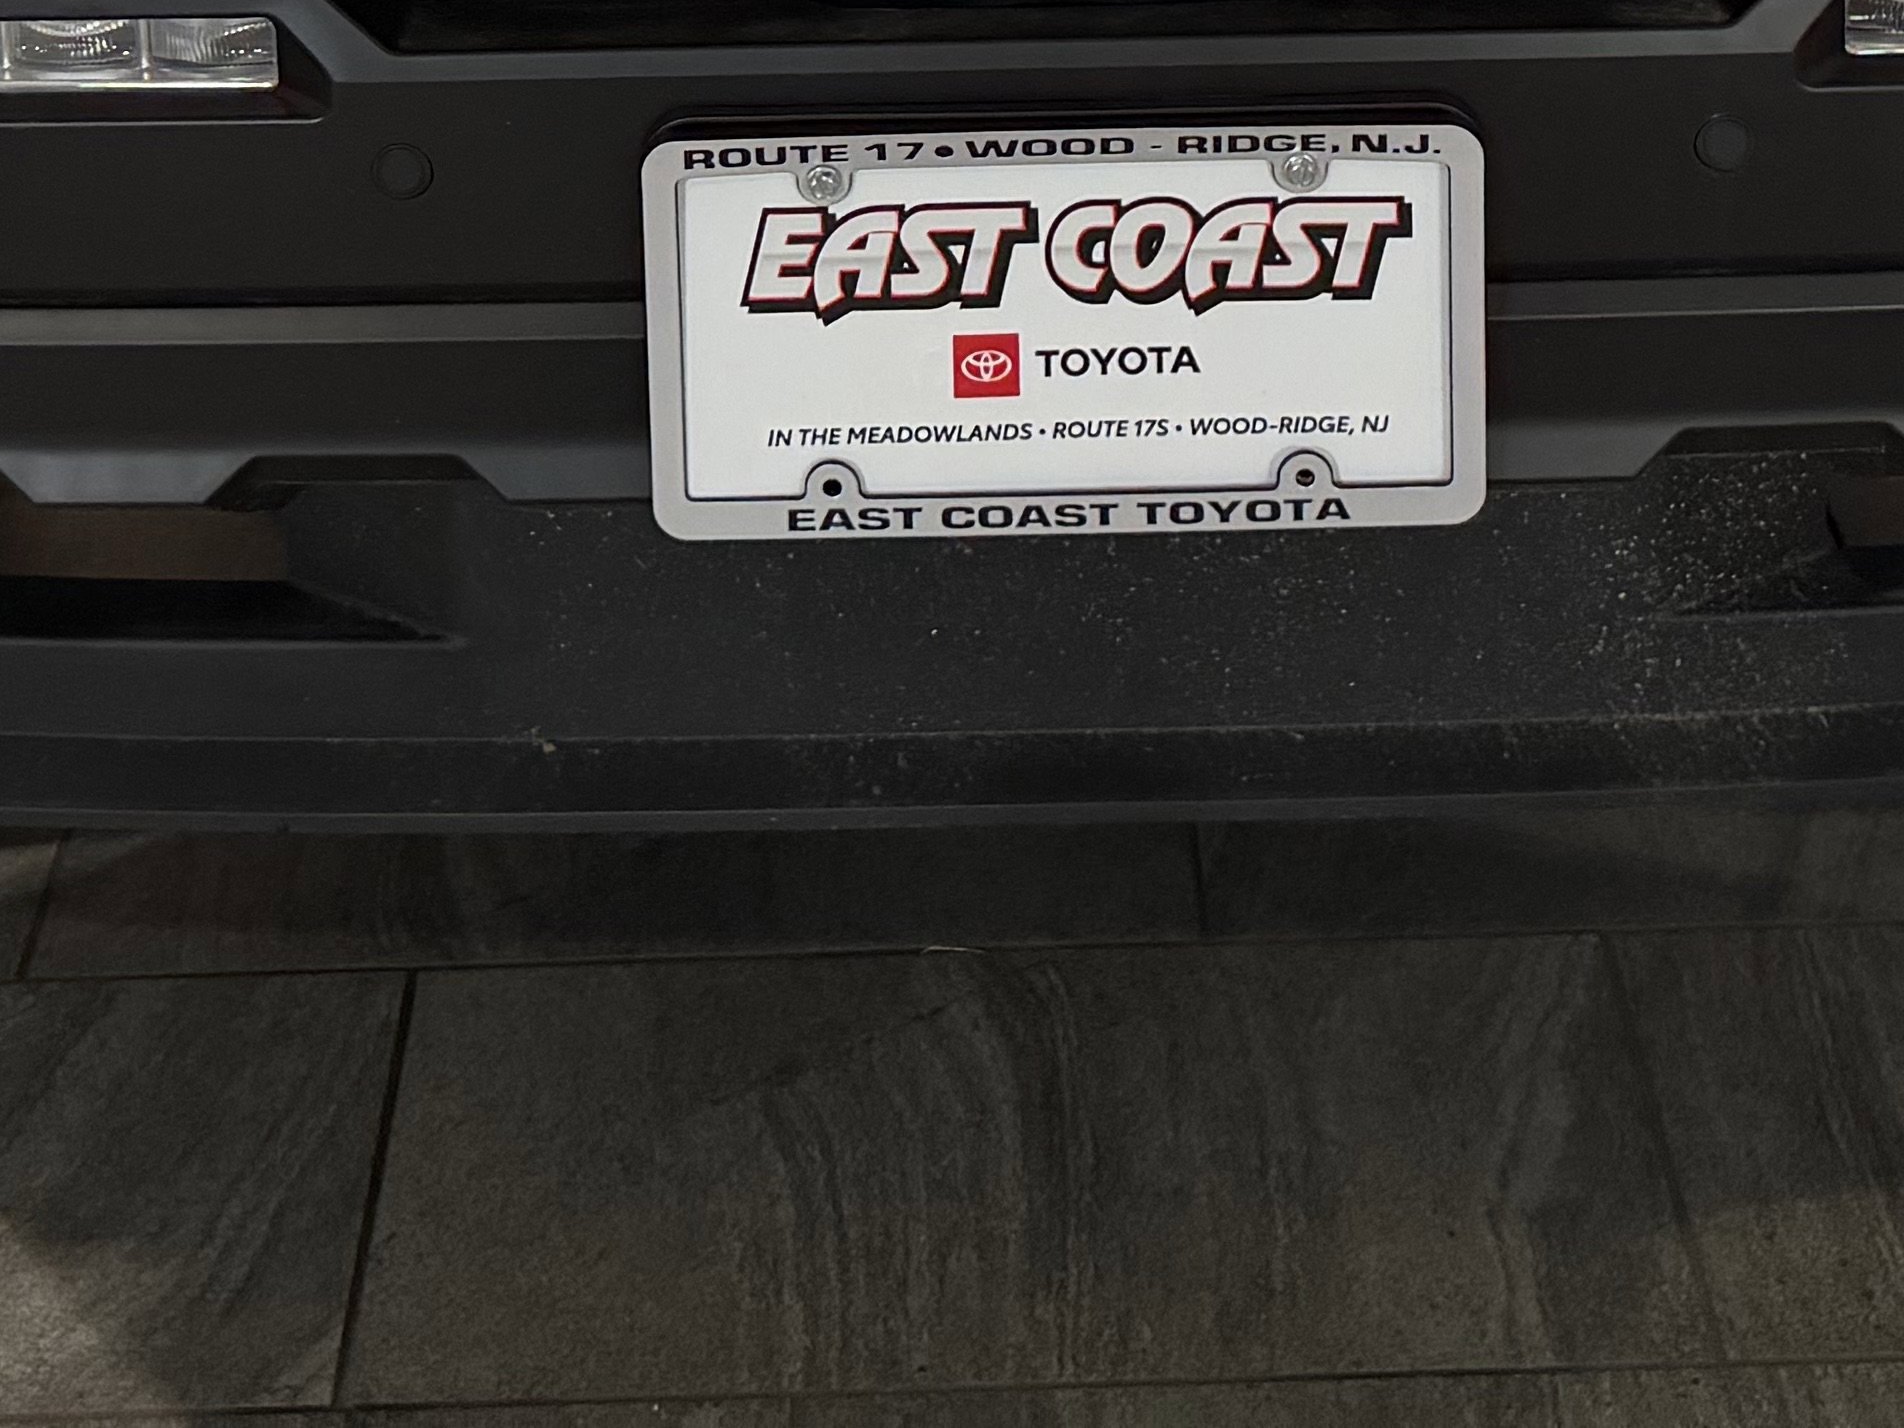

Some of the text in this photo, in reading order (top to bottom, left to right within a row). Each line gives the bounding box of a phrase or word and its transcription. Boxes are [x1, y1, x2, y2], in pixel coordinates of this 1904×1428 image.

[684, 143, 849, 170] ROUTE
[864, 142, 925, 162] 17
[965, 137, 1135, 158] WOOD
[1177, 133, 1340, 156] RIDGE,
[1352, 133, 1442, 154] N.J.
[739, 195, 1413, 327] EAST COAST
[1035, 346, 1201, 377] TOYOTA
[768, 415, 1390, 447] IN THE MEADOWLANDS ROUTE 17S WOOD-RIDGE, NJ
[787, 497, 1352, 532] EAST COAST TOYOTA
